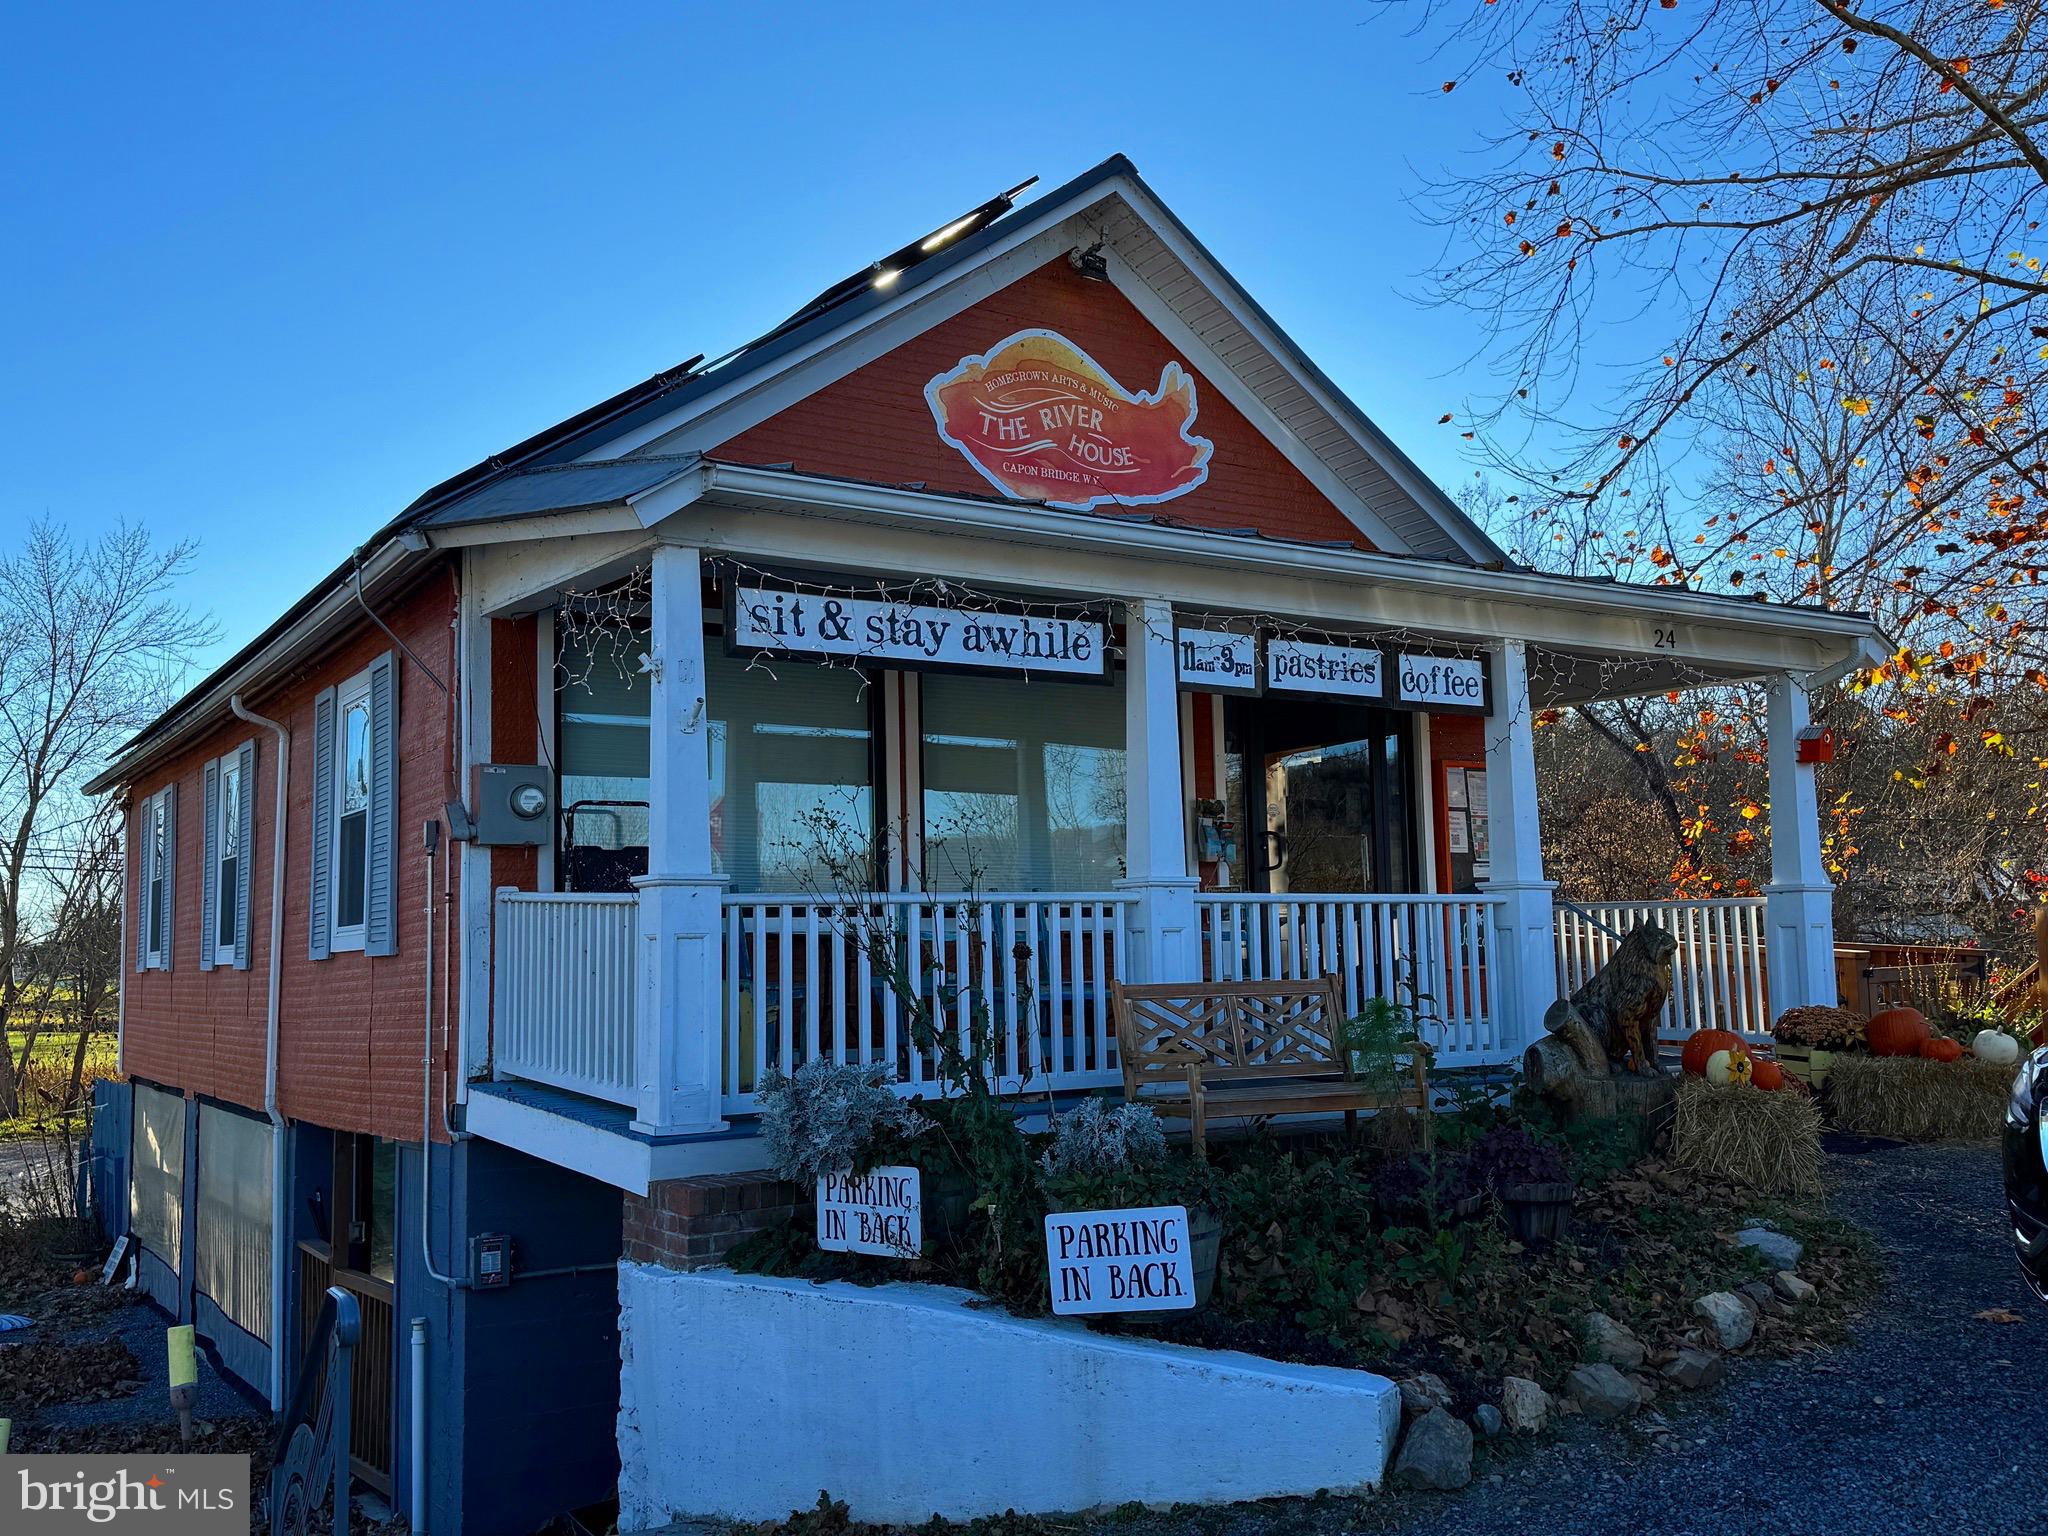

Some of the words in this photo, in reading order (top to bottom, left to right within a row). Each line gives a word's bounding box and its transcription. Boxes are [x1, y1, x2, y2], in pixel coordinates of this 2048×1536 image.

[985, 371, 1049, 393] HOMEGROWN
[1052, 374, 1079, 389] ARTS
[1080, 383, 1088, 393] &
[1089, 387, 1119, 413] MUSIC
[979, 411, 1031, 440] THE
[1039, 404, 1104, 432] RIVER
[1068, 433, 1134, 466] HOUSE
[1003, 462, 1038, 476] CAPON
[1040, 467, 1080, 483] BRIDGE
[750, 595, 806, 636] sit
[818, 600, 854, 641] &
[866, 607, 950, 657] stay
[962, 618, 1092, 662] awhile
[1654, 628, 1676, 648] 24
[1274, 652, 1376, 683] pastries
[1401, 665, 1479, 698] coffee
[825, 1173, 911, 1209] PARKING
[825, 1209, 846, 1240] IN
[859, 1211, 912, 1247] BACK
[1057, 1219, 1178, 1259] PARKING
[1060, 1266, 1092, 1301] IN
[1108, 1262, 1182, 1299] BACK
